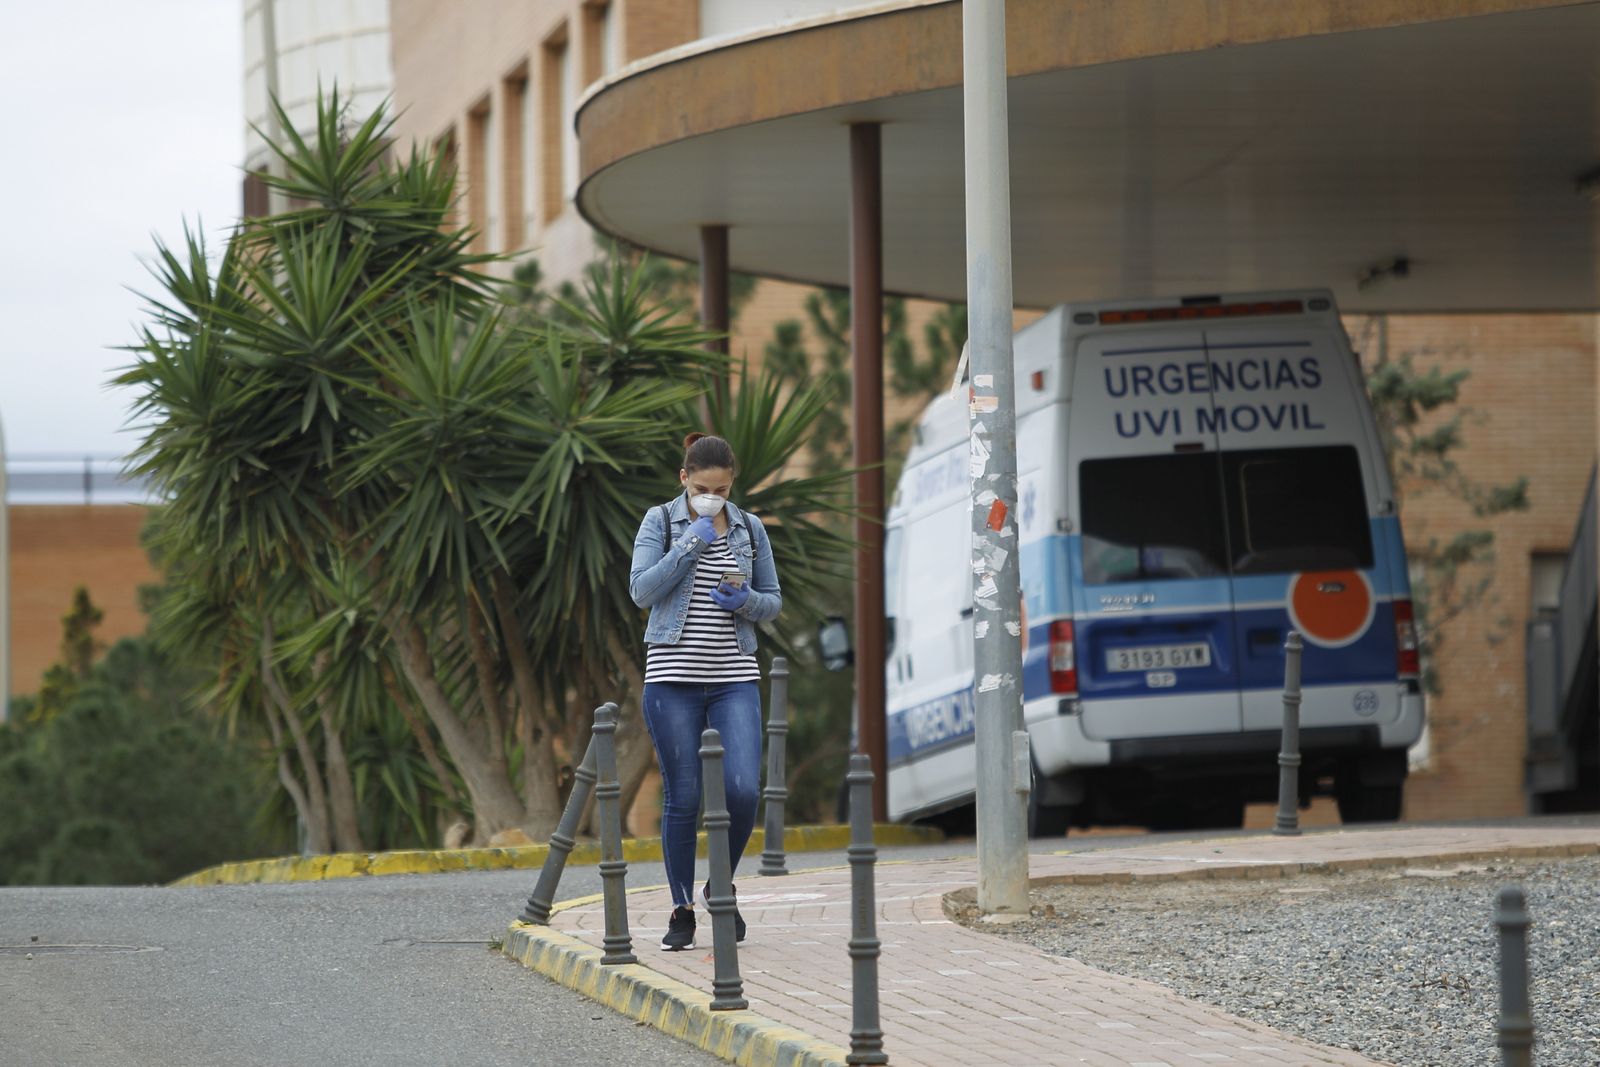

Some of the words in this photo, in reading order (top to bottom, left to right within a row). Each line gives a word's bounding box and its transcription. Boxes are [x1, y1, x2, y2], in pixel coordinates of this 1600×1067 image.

[1105, 357, 1322, 398] URGENCIAS
[1115, 407, 1182, 438] UVI
[1196, 402, 1326, 434] MOVIL
[1120, 650, 1165, 670] 3193
[905, 690, 975, 749] URGENCIA
